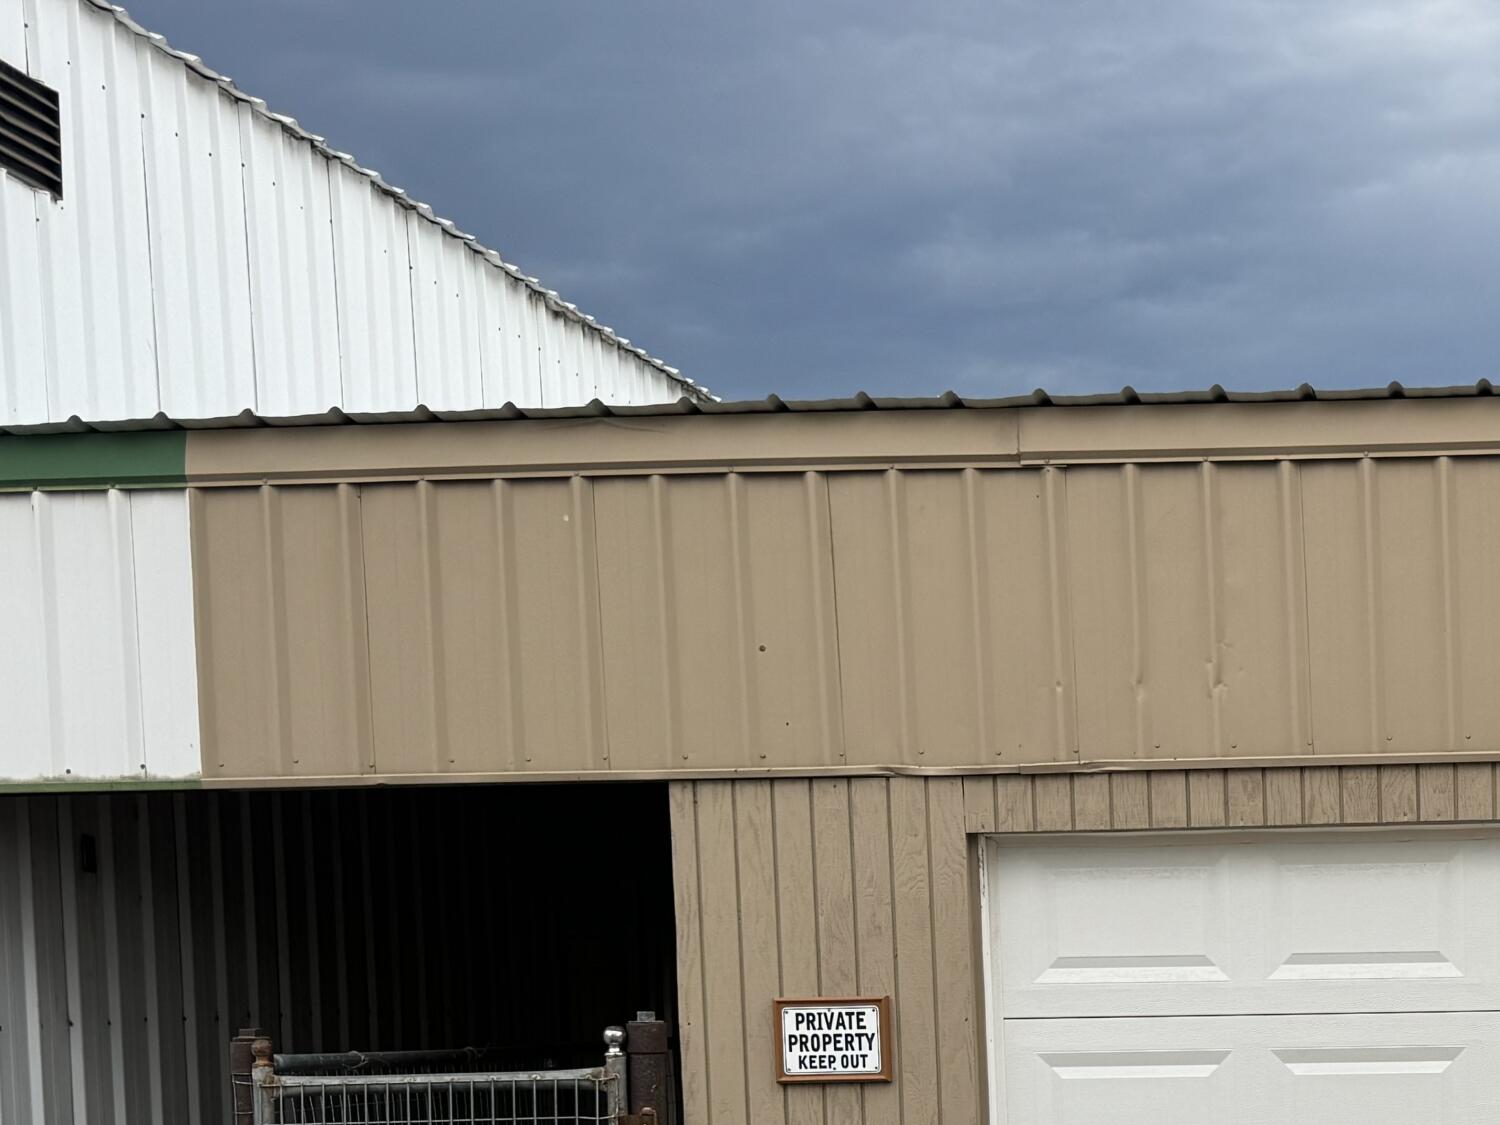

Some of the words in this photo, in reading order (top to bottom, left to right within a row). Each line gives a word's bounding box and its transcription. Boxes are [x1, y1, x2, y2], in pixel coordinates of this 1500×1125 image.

[795, 1011, 867, 1031] PRIVATE
[788, 1033, 876, 1052] PROPERTY
[798, 1055, 837, 1069] KEEP
[841, 1054, 868, 1069] OUT
